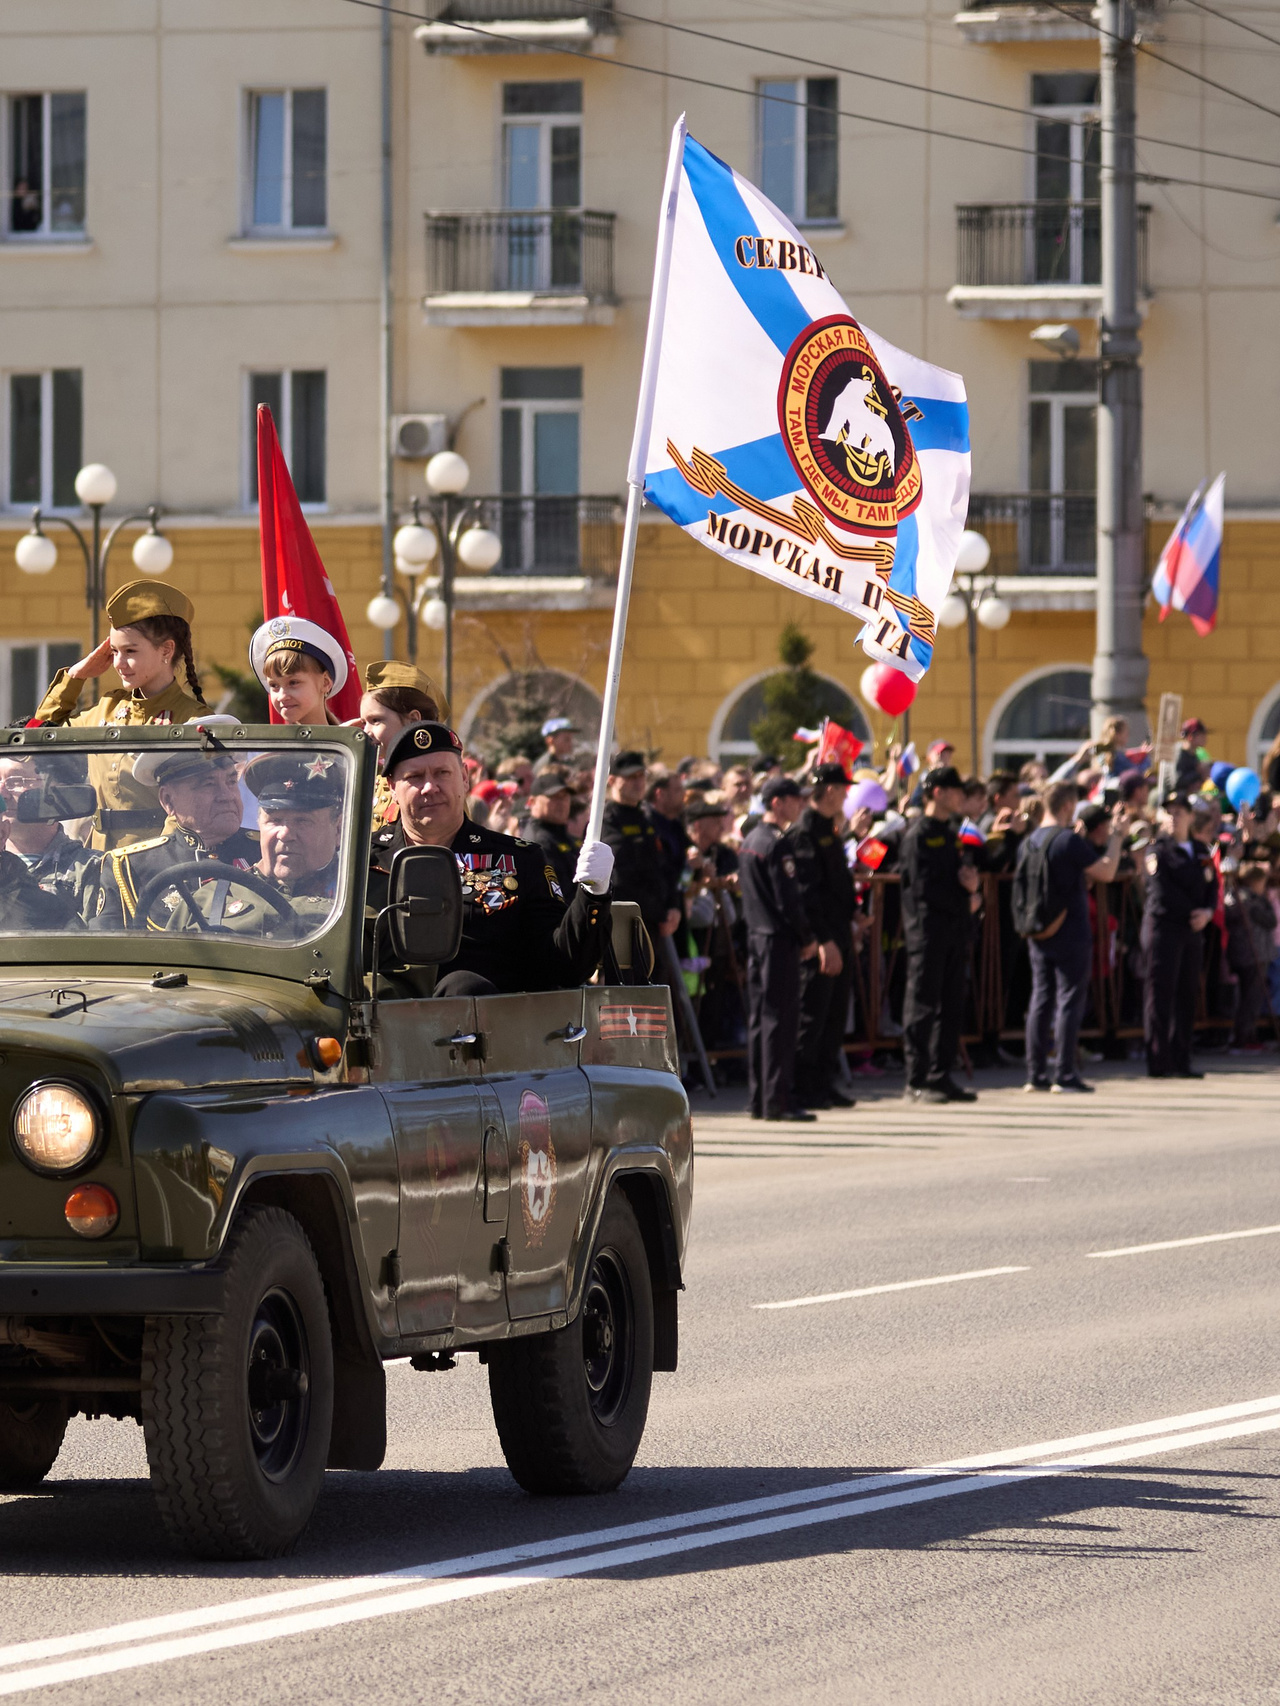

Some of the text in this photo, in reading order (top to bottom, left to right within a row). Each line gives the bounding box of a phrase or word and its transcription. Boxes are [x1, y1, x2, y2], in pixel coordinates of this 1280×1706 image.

[791, 328, 844, 395] МОРСКАЯ
[788, 407, 805, 451] ТАМ,
[800, 453, 825, 489] ГДЕ
[821, 484, 849, 515] МЫ,
[856, 502, 888, 521] ТАМ
[706, 510, 845, 595] МОРСКАЯ
